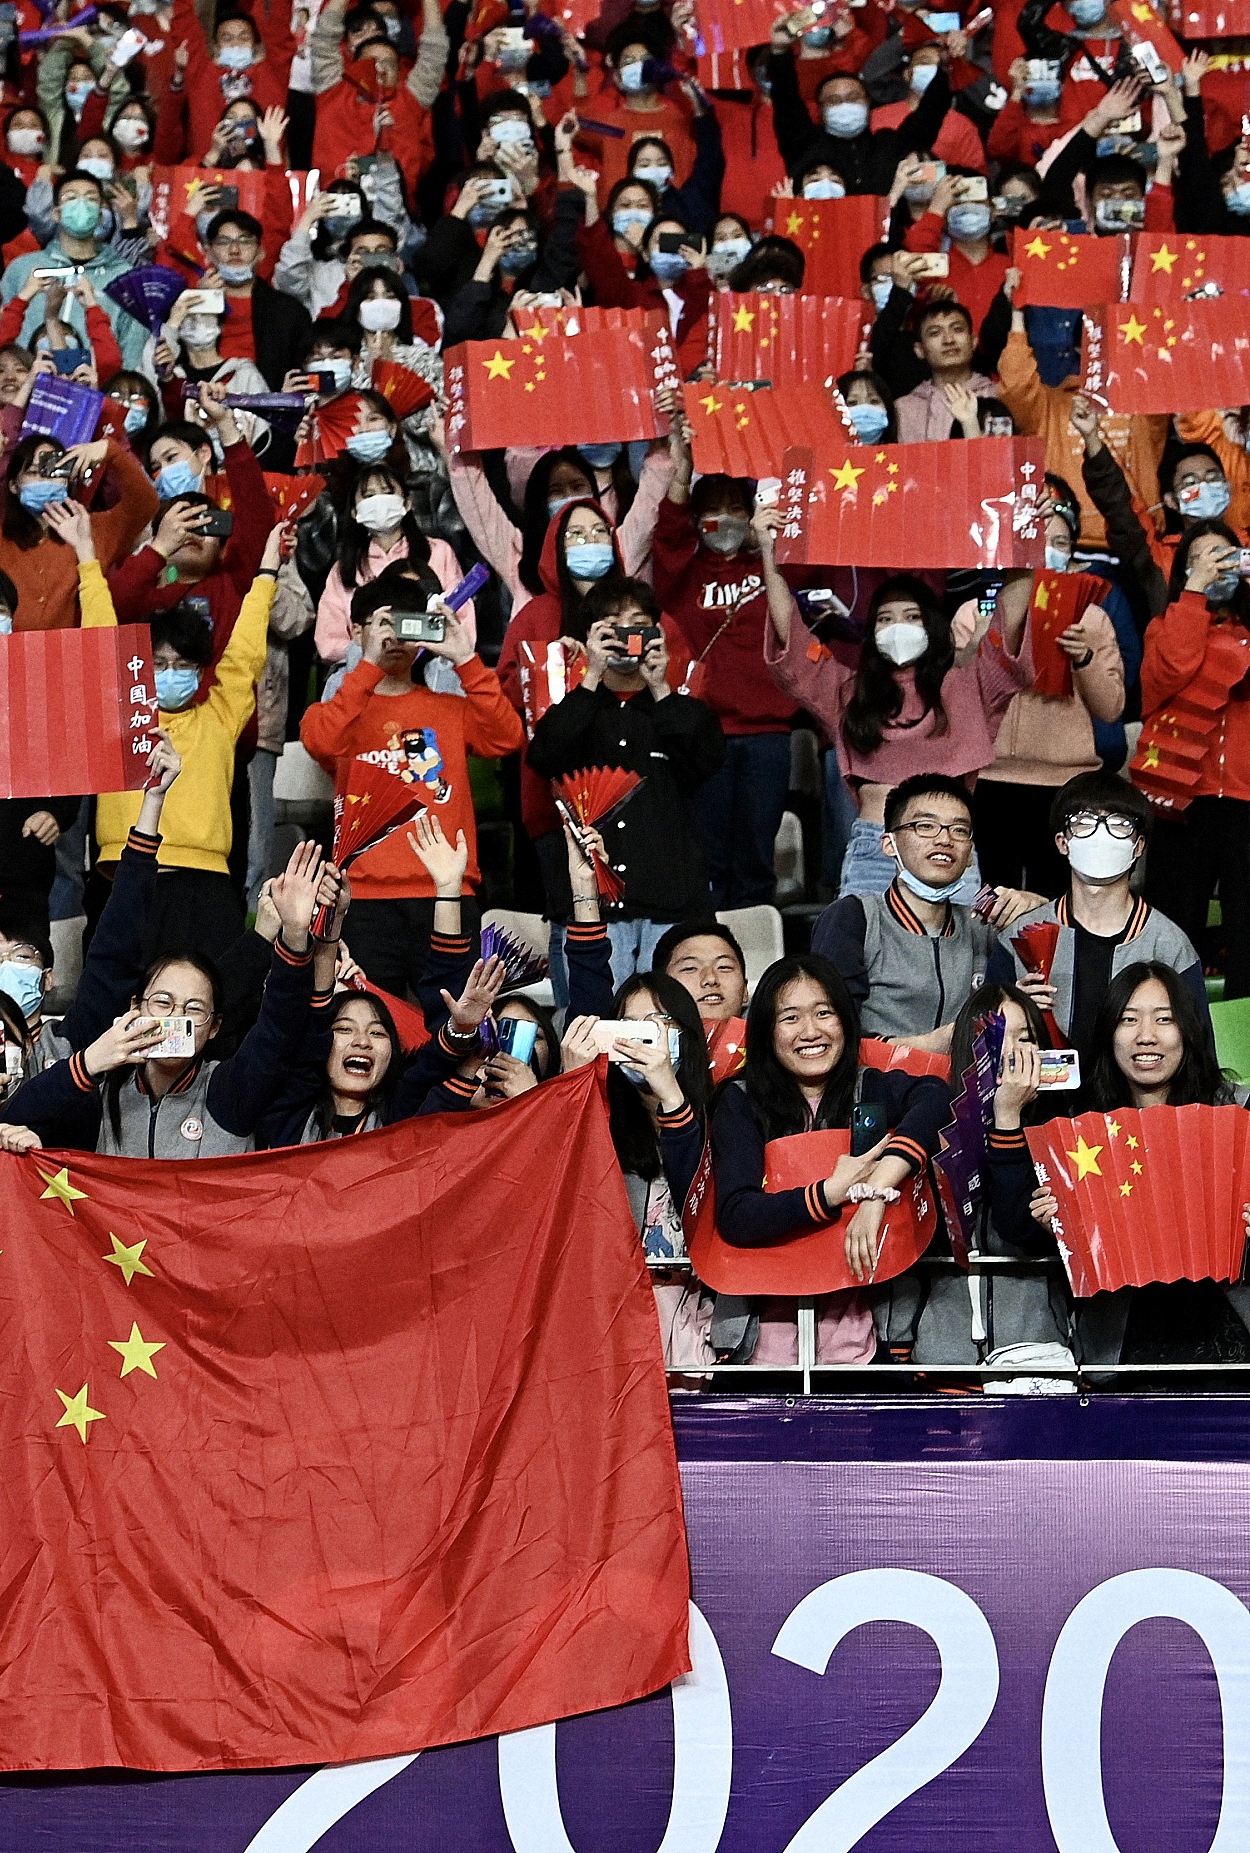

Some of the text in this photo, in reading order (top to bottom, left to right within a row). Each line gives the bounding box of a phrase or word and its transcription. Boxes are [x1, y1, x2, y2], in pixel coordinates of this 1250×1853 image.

[127, 655, 152, 755] 中国加油
[244, 1566, 1250, 1853] 020
